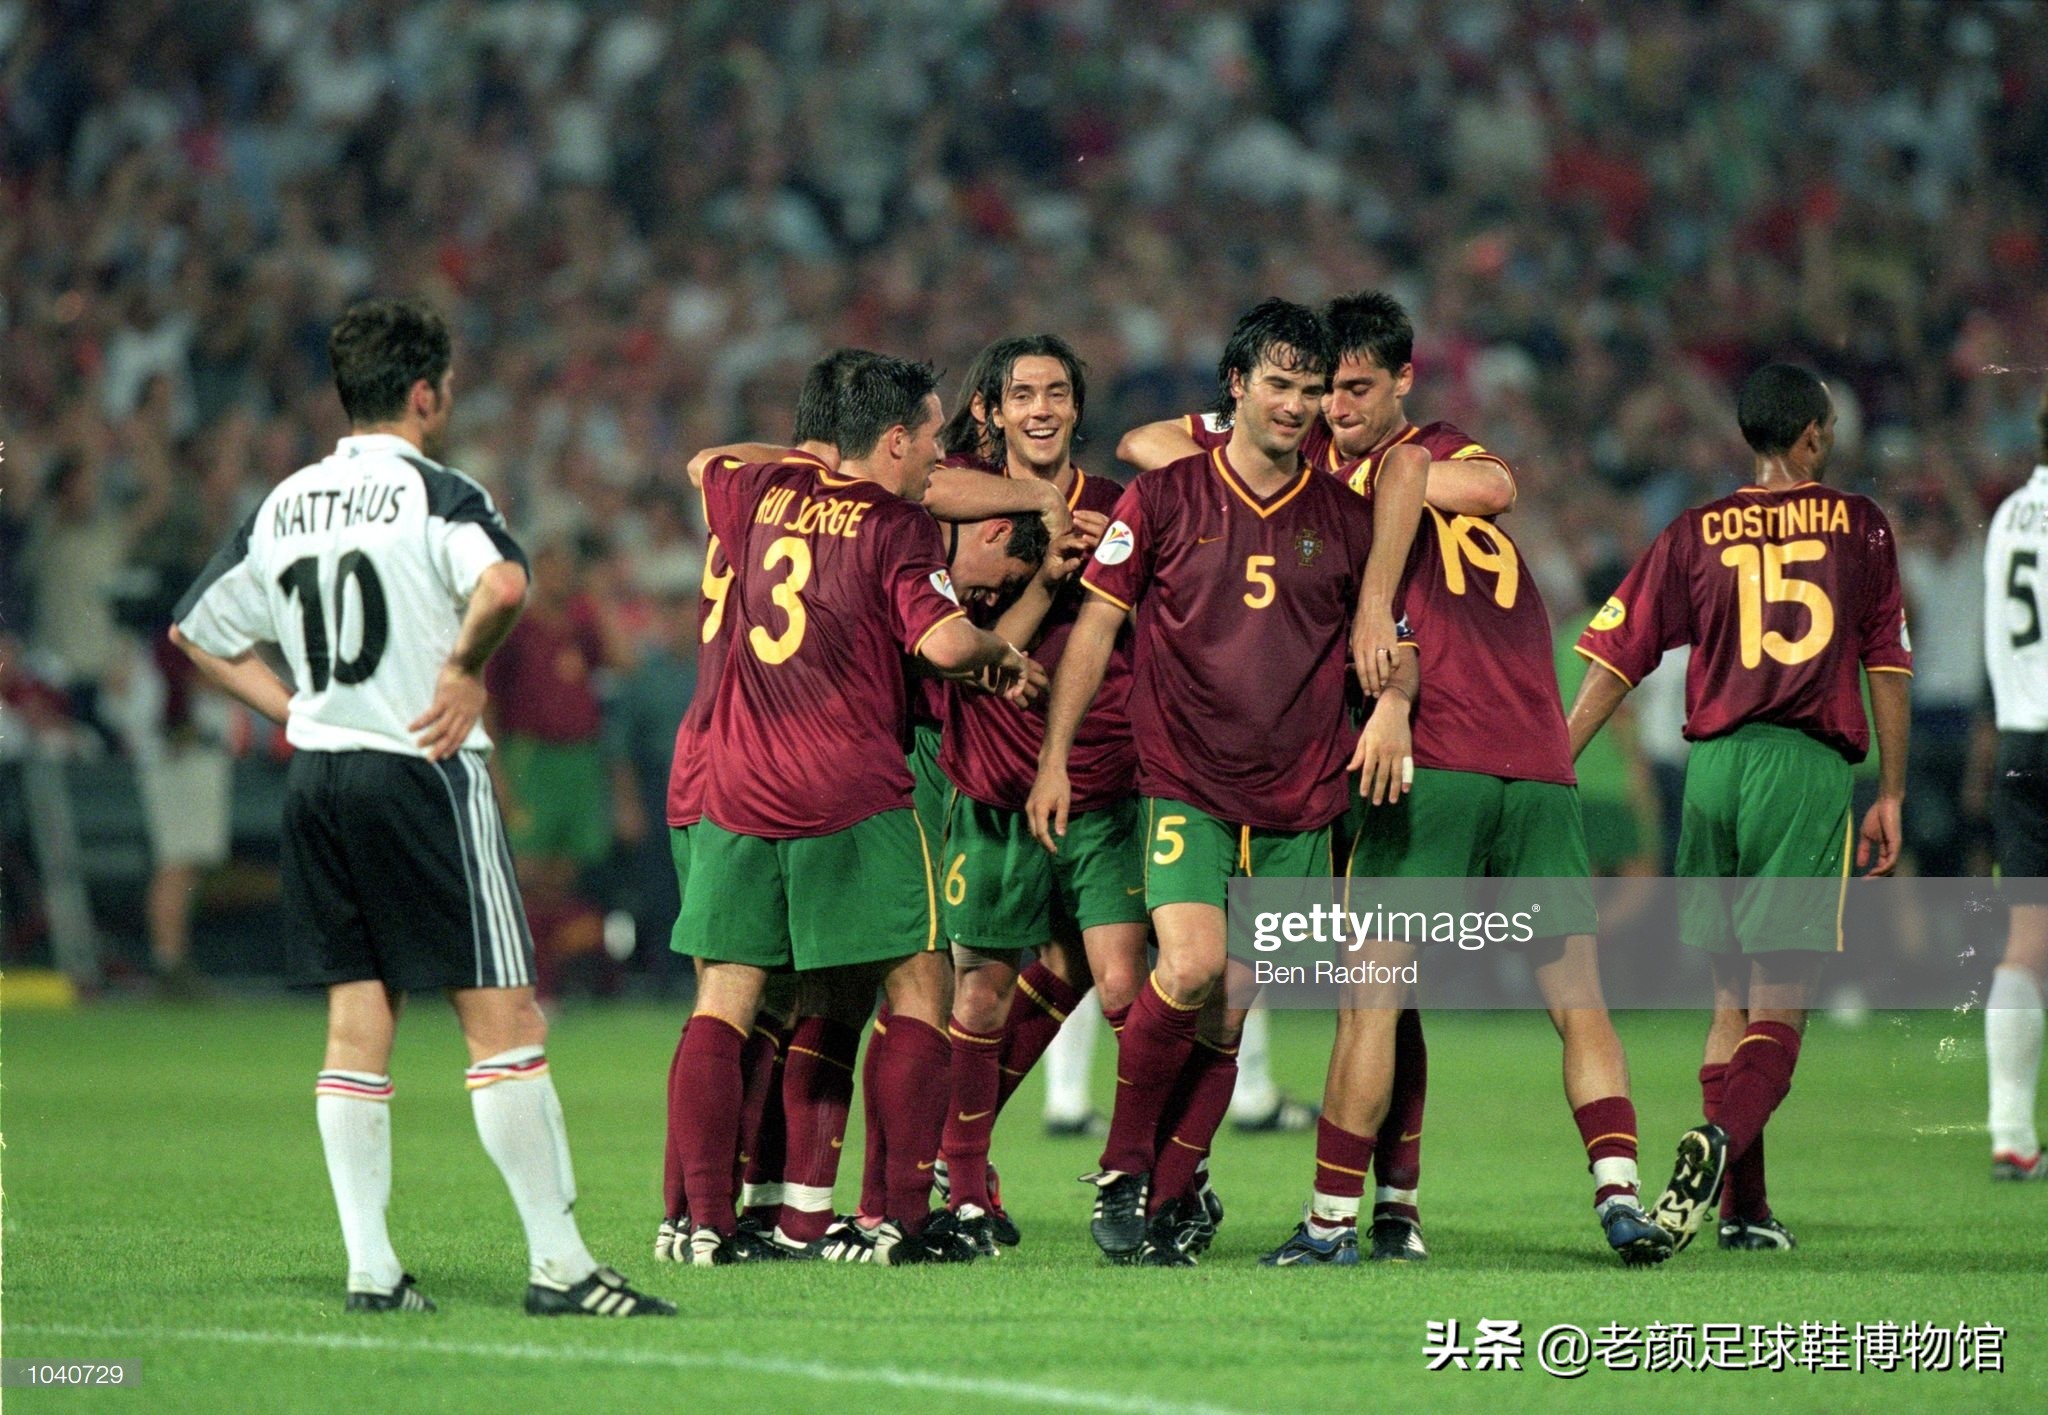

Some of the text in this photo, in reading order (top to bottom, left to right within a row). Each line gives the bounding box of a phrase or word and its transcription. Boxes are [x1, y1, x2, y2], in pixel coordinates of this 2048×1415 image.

[784, 495, 873, 538] JORGE
[1424, 500, 1519, 609] 19
[1702, 499, 1850, 545] COSTINHA
[277, 548, 388, 692] 10
[749, 536, 812, 665] 3
[1243, 555, 1276, 609] 5
[1721, 540, 1834, 669] 15
[2007, 549, 2042, 648] 5
[1153, 815, 1187, 865] 5
[945, 853, 966, 906] 6
